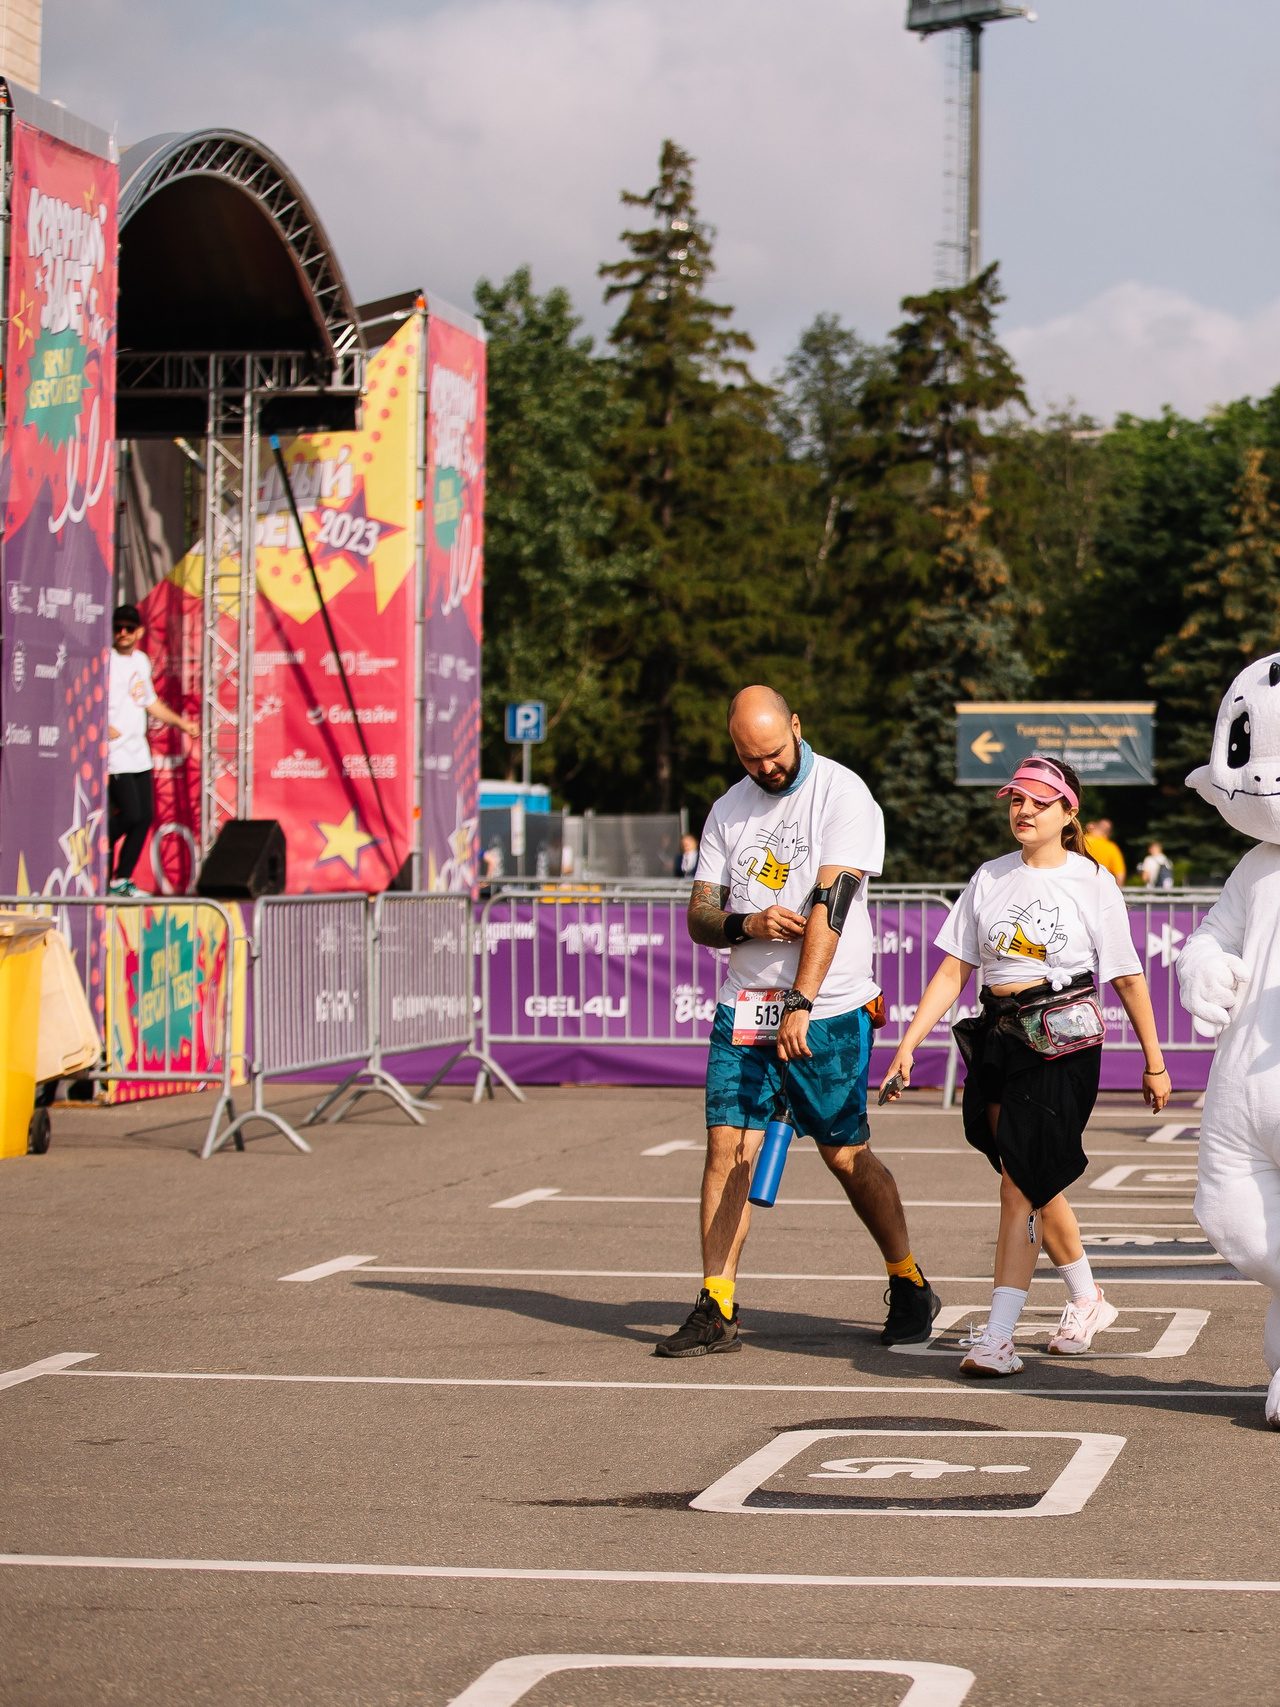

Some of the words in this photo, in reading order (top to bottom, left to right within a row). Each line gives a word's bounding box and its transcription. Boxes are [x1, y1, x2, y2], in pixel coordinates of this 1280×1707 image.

[315, 507, 381, 556] 2023
[328, 704, 397, 724] билайн
[773, 868, 780, 880] 1
[525, 995, 627, 1018] GEL4U
[755, 1004, 784, 1027] 513
